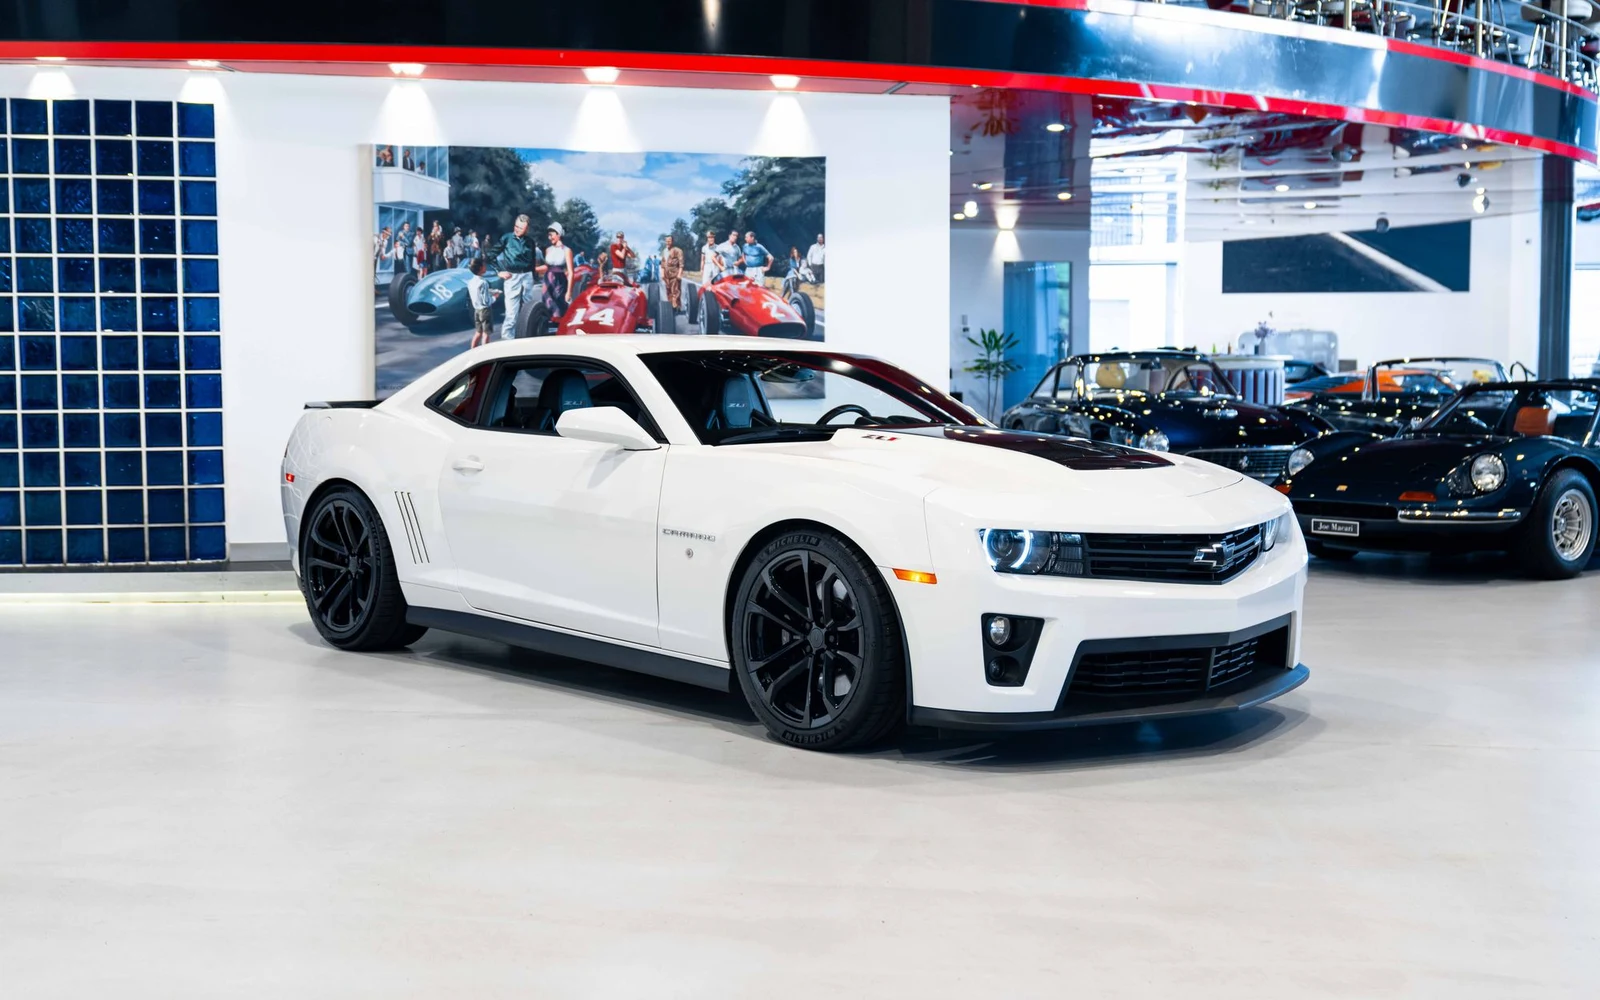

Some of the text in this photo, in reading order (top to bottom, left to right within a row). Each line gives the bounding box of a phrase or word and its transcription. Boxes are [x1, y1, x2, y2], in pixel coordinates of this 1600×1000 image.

[429, 284, 453, 301] 18
[566, 308, 615, 327] 14
[662, 528, 716, 542] CAMARO
[1318, 522, 1354, 532] Joe Macari
[768, 535, 818, 552] MICHELIN
[784, 729, 836, 744] MICHELIN
